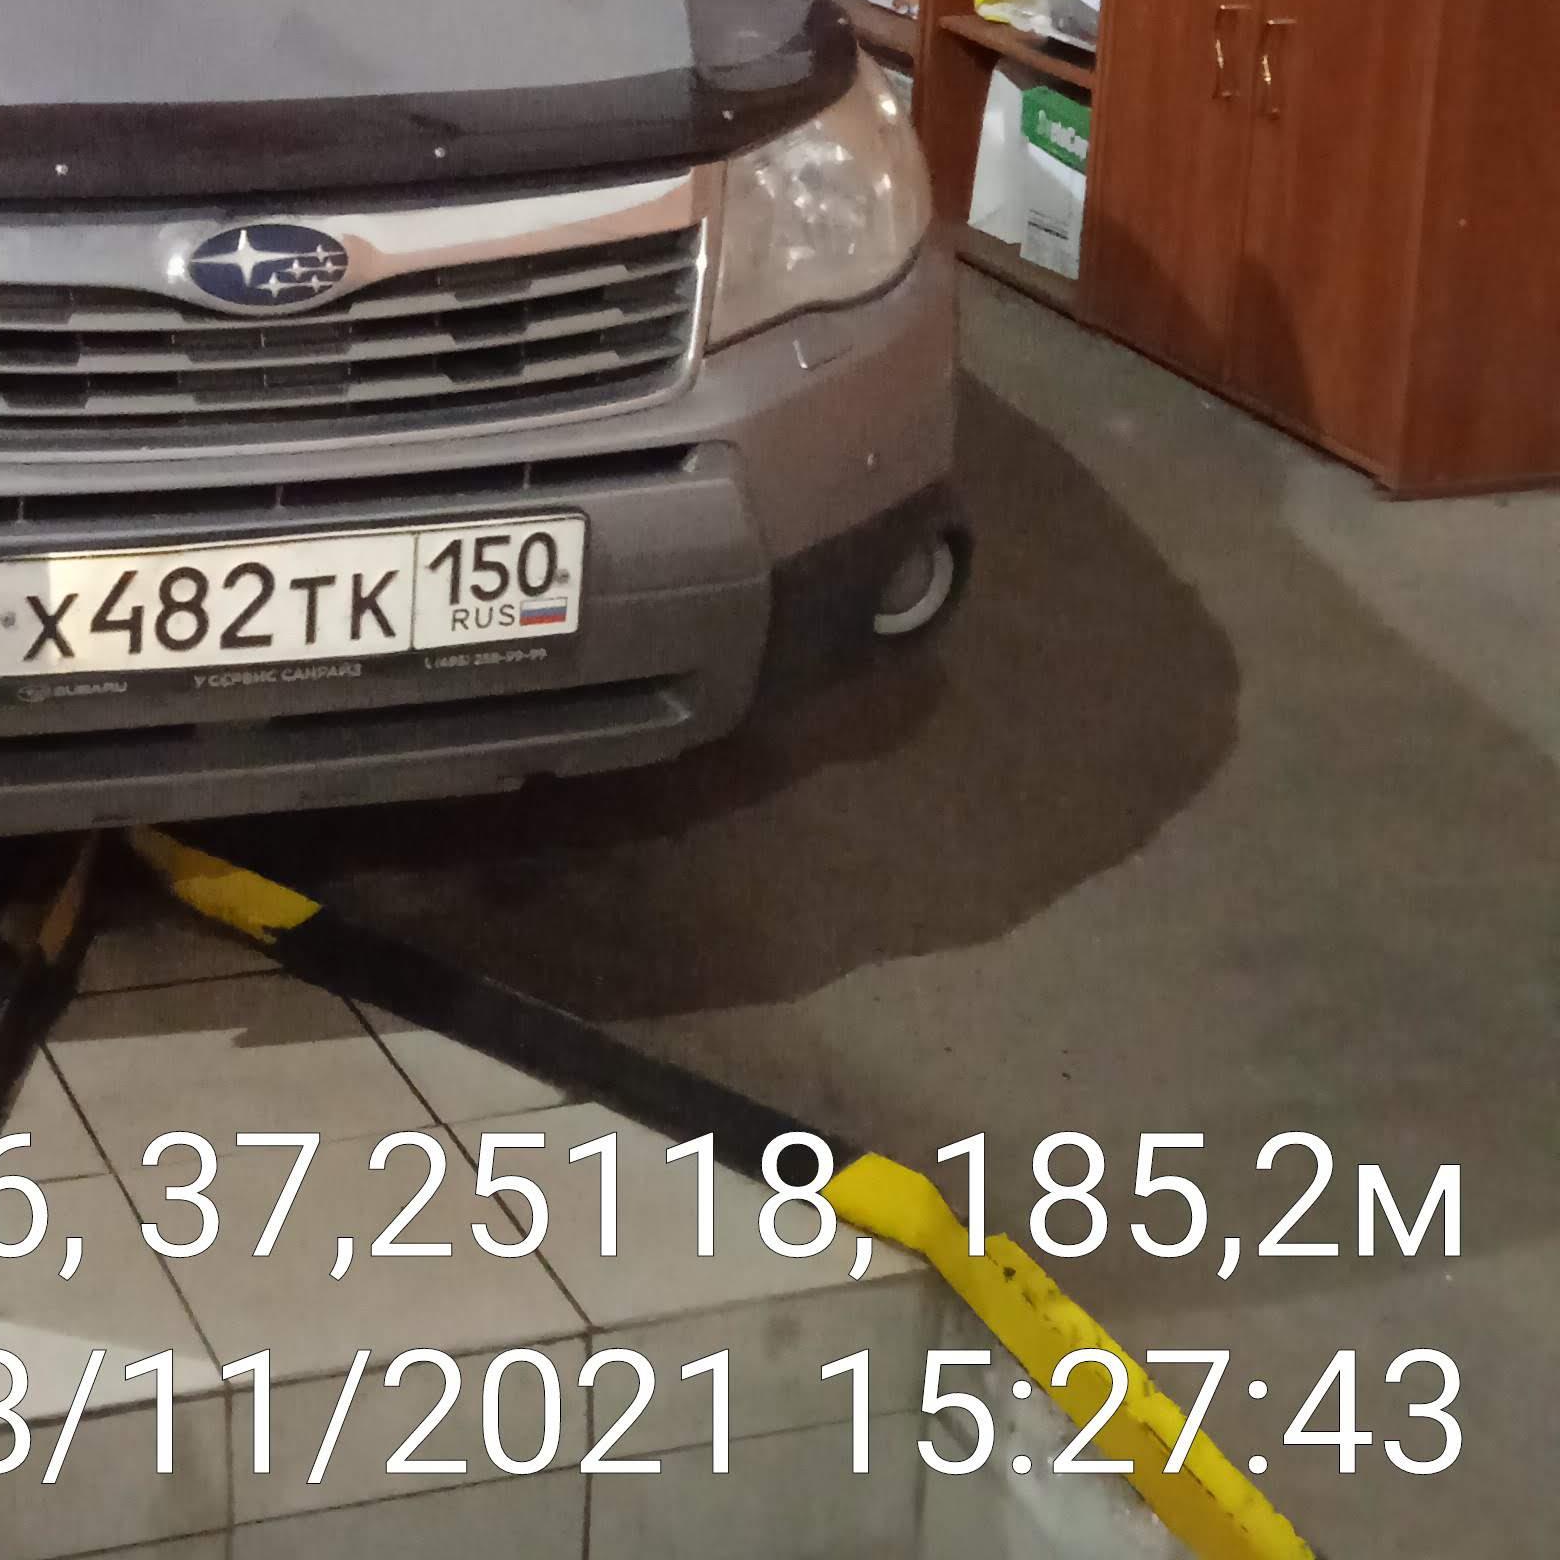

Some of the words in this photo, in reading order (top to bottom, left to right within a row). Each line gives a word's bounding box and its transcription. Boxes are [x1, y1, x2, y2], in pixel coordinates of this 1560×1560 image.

[23, 561, 398, 662] Х482ТК
[428, 531, 559, 606] 150
[451, 603, 517, 632] RUS
[53, 680, 128, 697] SUBARU
